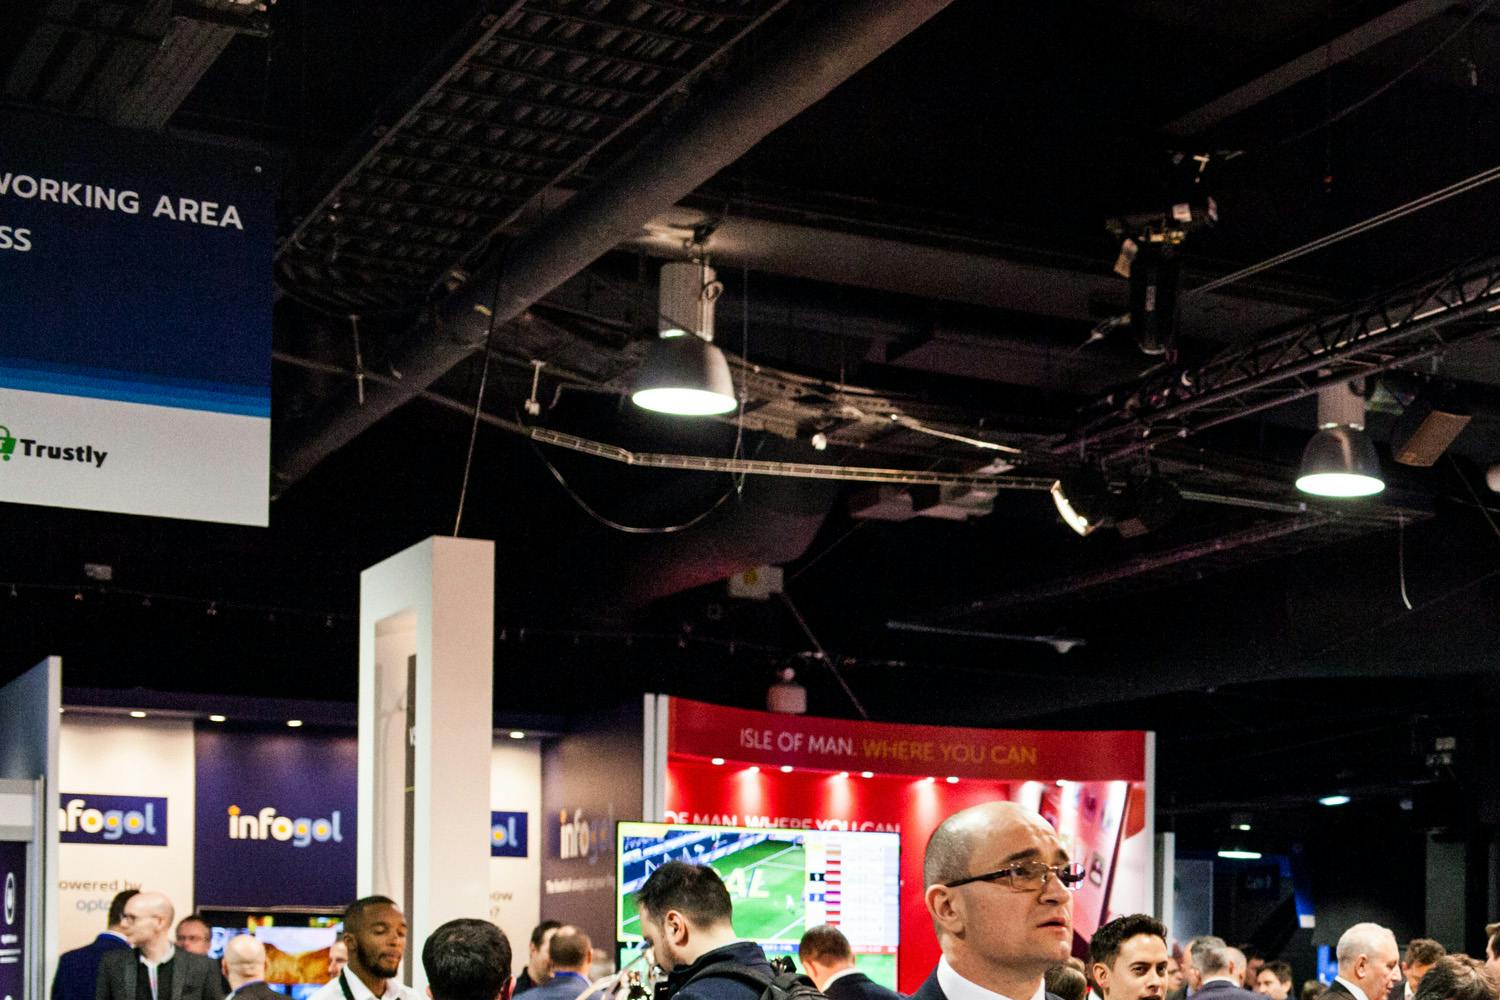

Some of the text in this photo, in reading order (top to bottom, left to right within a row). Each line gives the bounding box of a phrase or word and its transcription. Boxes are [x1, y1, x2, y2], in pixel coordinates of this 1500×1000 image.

[152, 194, 244, 230] AREA
[20, 438, 108, 468] Trustly
[739, 727, 1038, 766] ISLE OF MAN. WHERE YOU CAN
[227, 804, 344, 848] infogol
